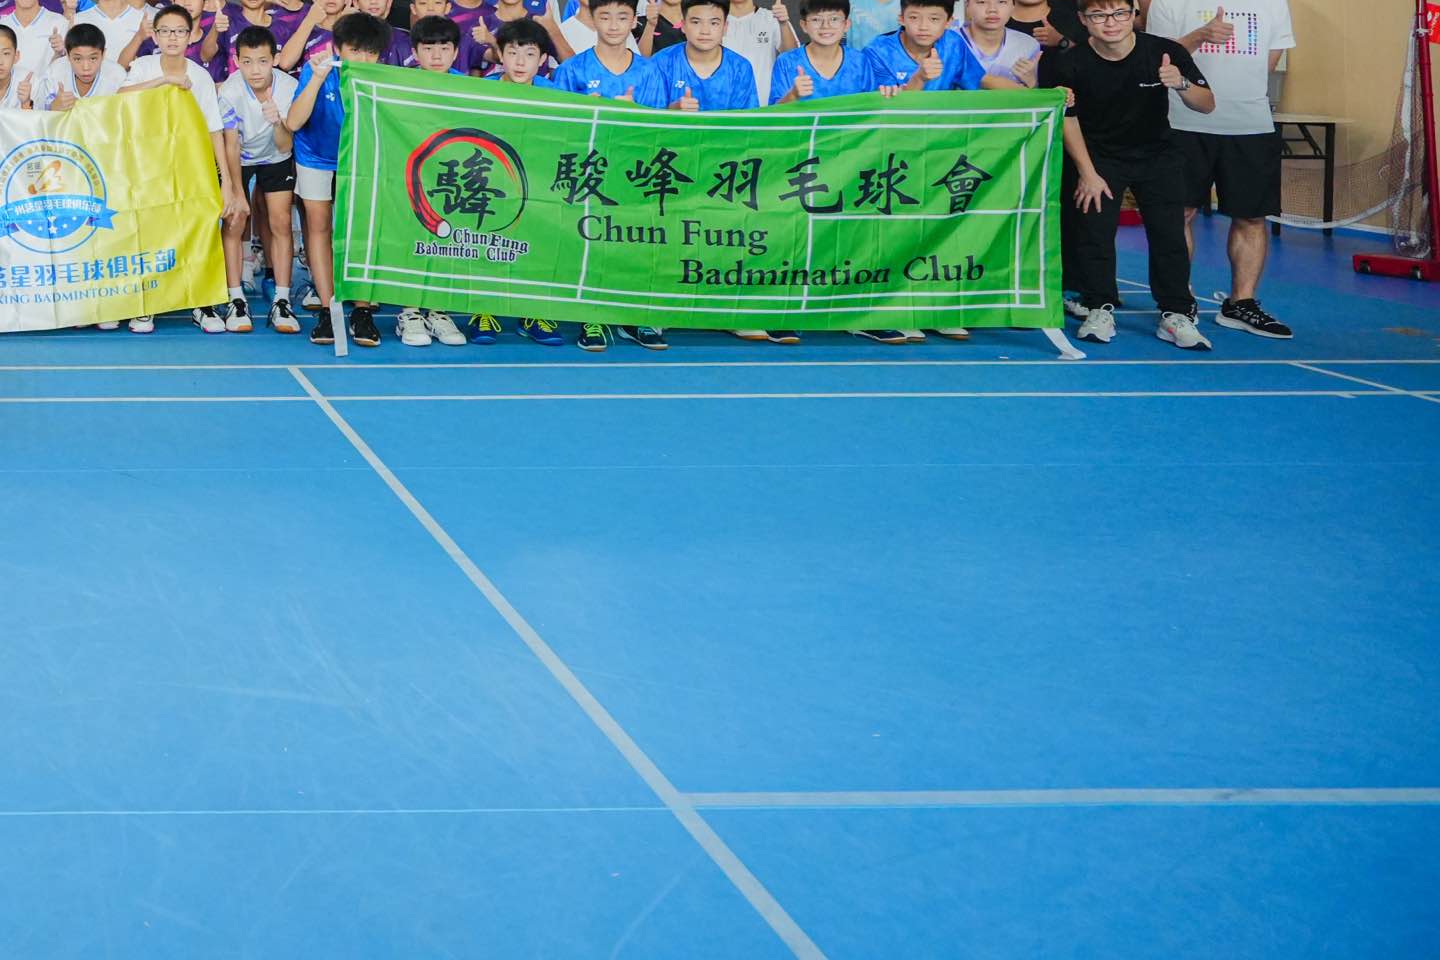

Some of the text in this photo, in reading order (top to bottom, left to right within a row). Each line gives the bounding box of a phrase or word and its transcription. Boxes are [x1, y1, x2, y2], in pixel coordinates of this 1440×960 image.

[549, 147, 993, 217] 駿峰羽毛球會
[453, 228, 529, 254] Chun Fung
[577, 214, 769, 256] Chun Fung
[415, 241, 517, 262] Badminton Club
[678, 254, 985, 286] Badmination Club
[34, 286, 120, 304] BADMINTON
[124, 280, 159, 295] CLUB
